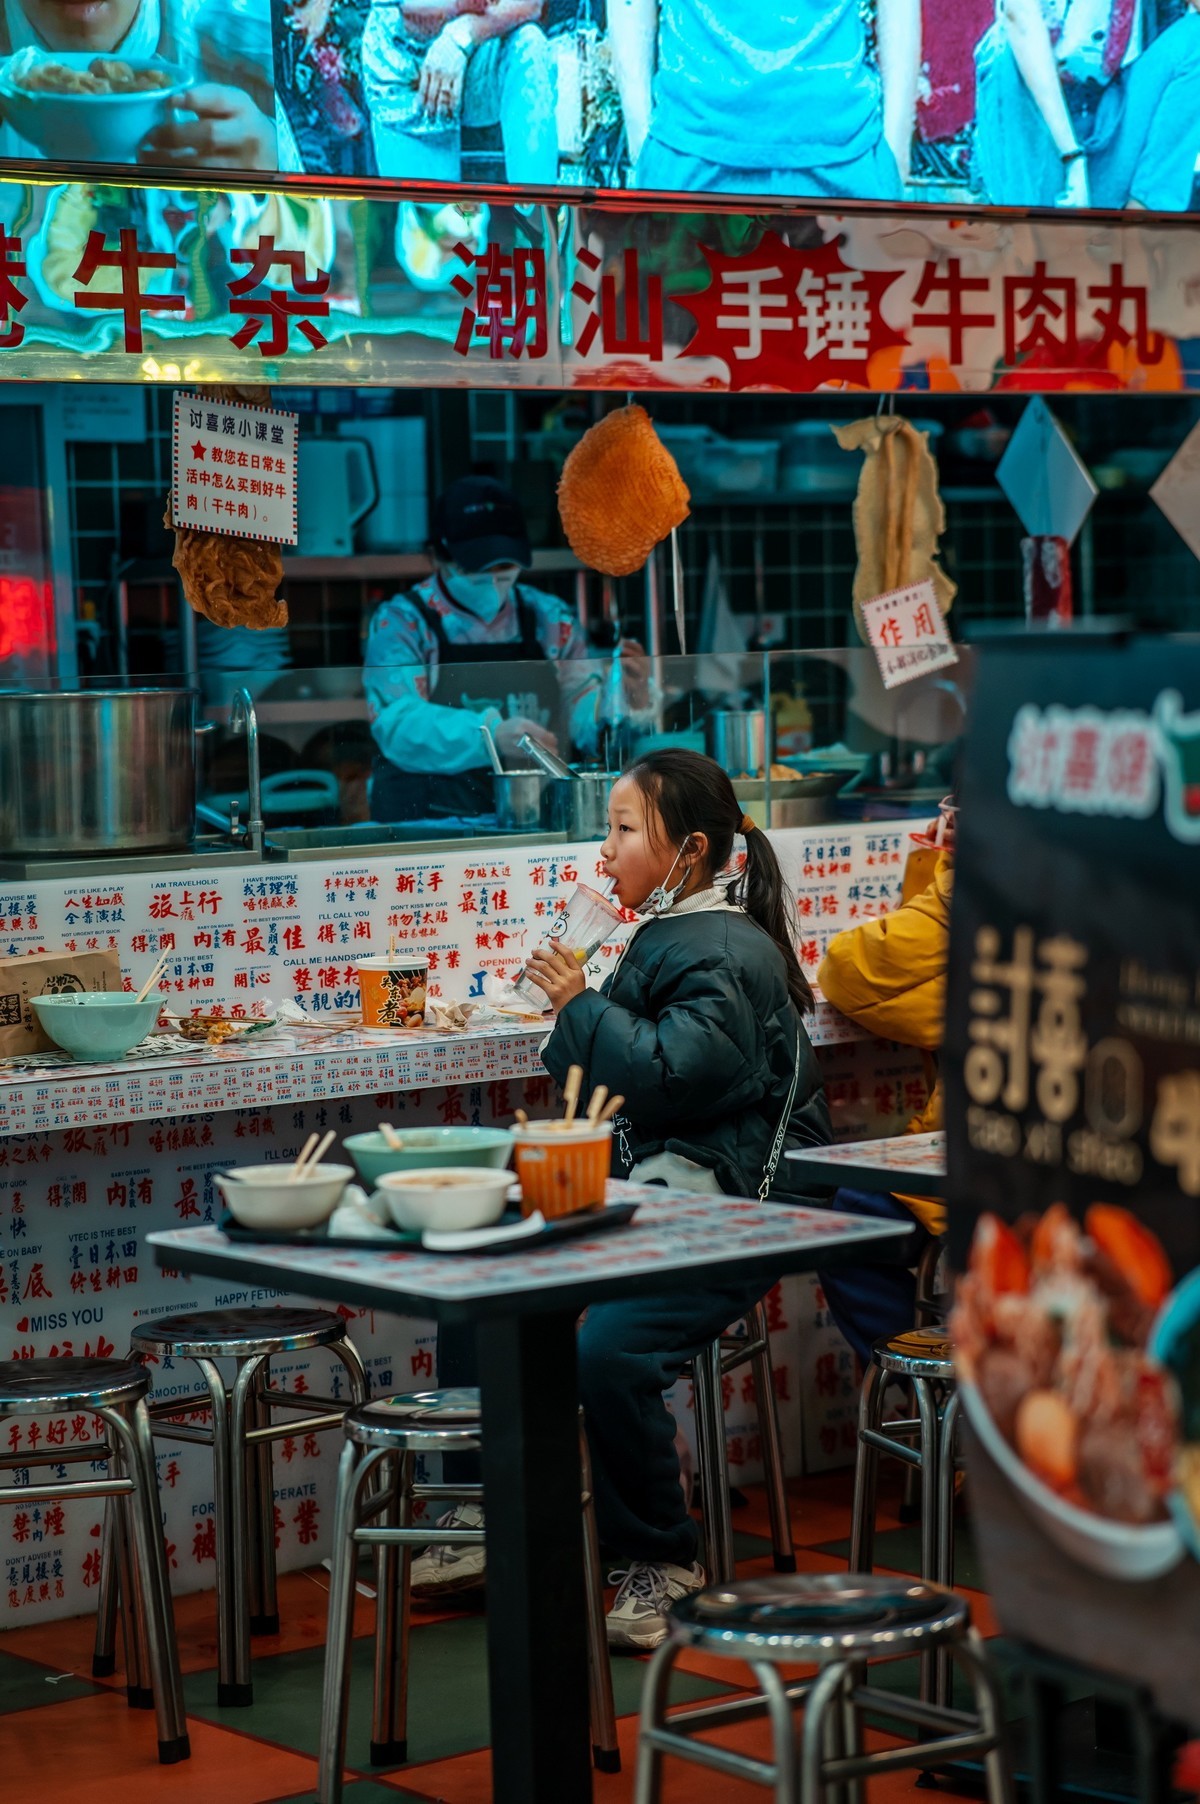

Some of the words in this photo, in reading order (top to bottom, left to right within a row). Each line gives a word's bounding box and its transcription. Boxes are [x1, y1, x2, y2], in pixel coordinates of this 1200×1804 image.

[450, 242, 663, 361] 潮汕
[716, 266, 872, 361] 手锤
[912, 258, 1164, 365] 牛肉丸
[190, 408, 284, 445] 讨喜烧小课堂
[211, 446, 287, 475] 教您在日常生
[186, 467, 287, 499] 活中怎么买到好牛
[168, 878, 219, 888] TRAVELHOLIC
[265, 874, 298, 882] PRINCIPLE
[386, 947, 414, 955] FRCED
[283, 959, 306, 967] CALL
[479, 957, 522, 968] OPENING
[196, 997, 213, 1005] hope
[377, 975, 402, 1025] 关东煮
[68, 1231, 89, 1242] VTEC
[101, 1228, 115, 1238] THE
[117, 1225, 137, 1236] BEST
[21, 1244, 42, 1256] BABY
[215, 1292, 249, 1306] HAPPY
[31, 1312, 68, 1333] MISS
[72, 1307, 104, 1326] YOU
[149, 1385, 190, 1399] SMOOTH
[27, 1550, 52, 1562] ADVISE
[53, 1549, 63, 1557] ME
